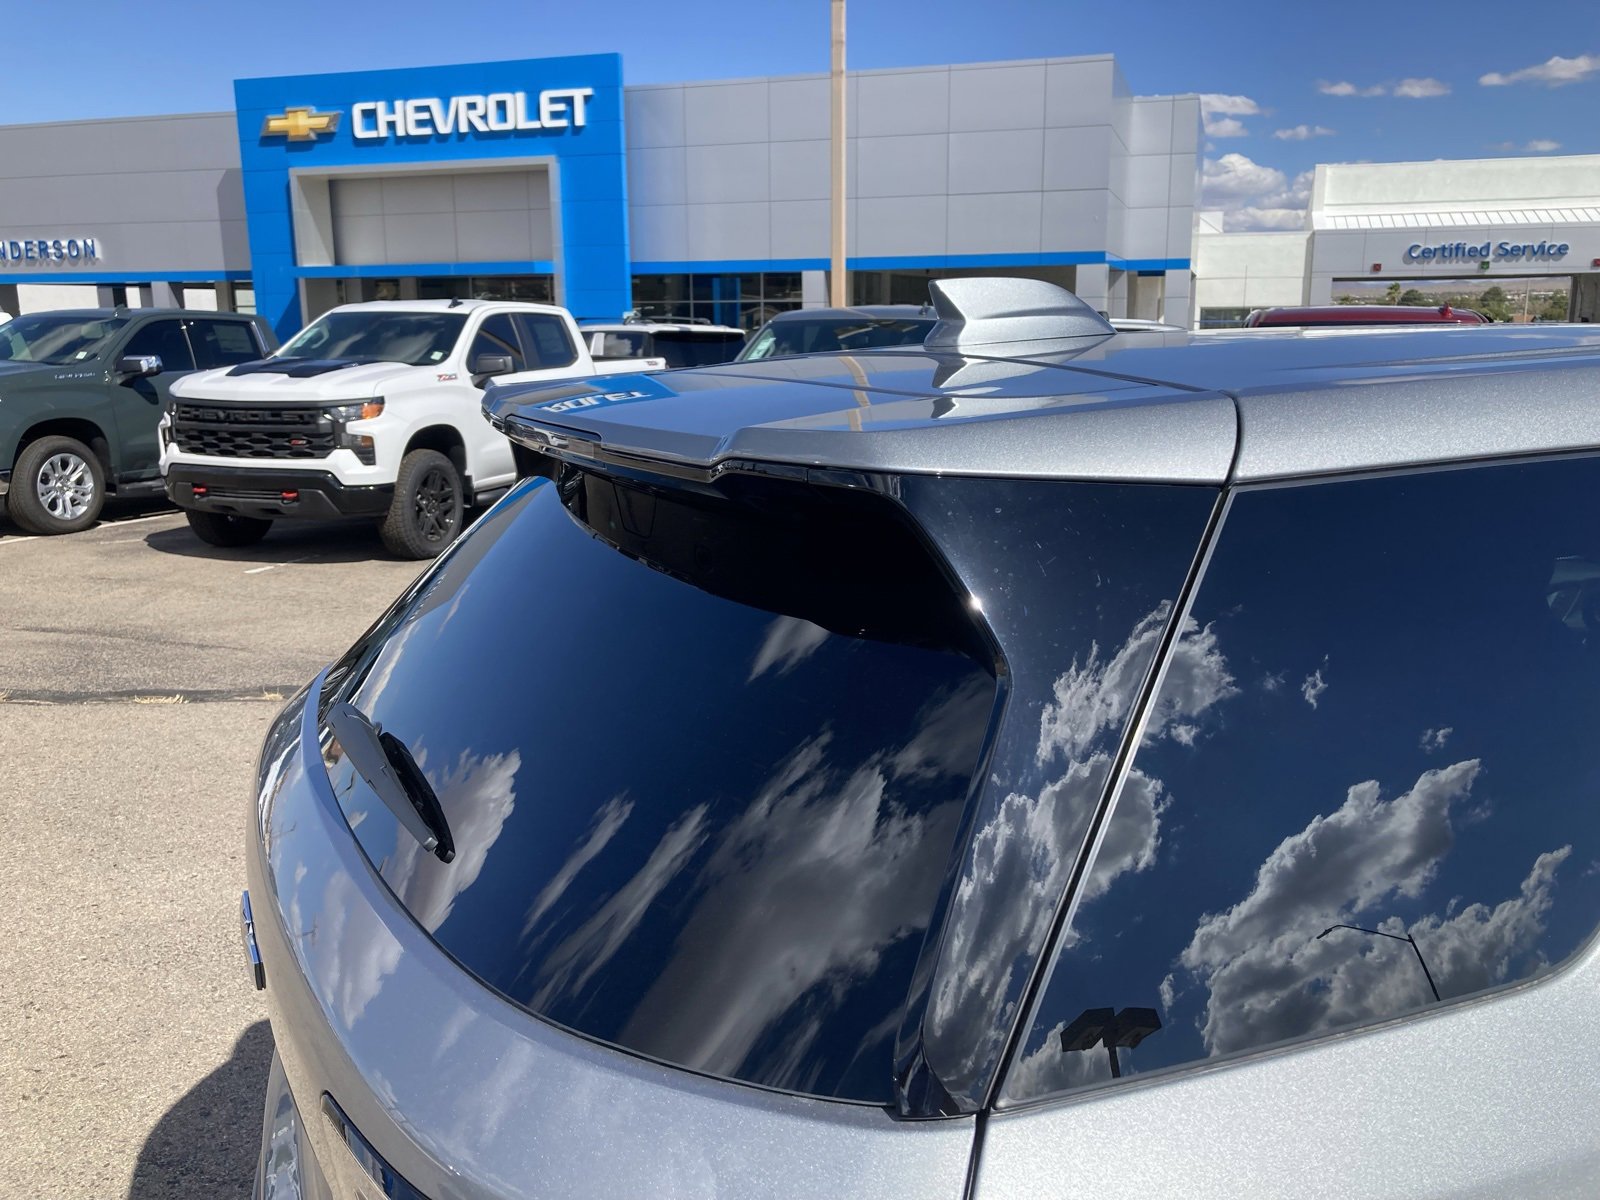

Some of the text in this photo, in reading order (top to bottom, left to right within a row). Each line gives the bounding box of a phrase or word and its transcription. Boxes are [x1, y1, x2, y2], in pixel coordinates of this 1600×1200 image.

[352, 88, 594, 139] CHEVROLET
[1408, 240, 1570, 259] Certified Service
